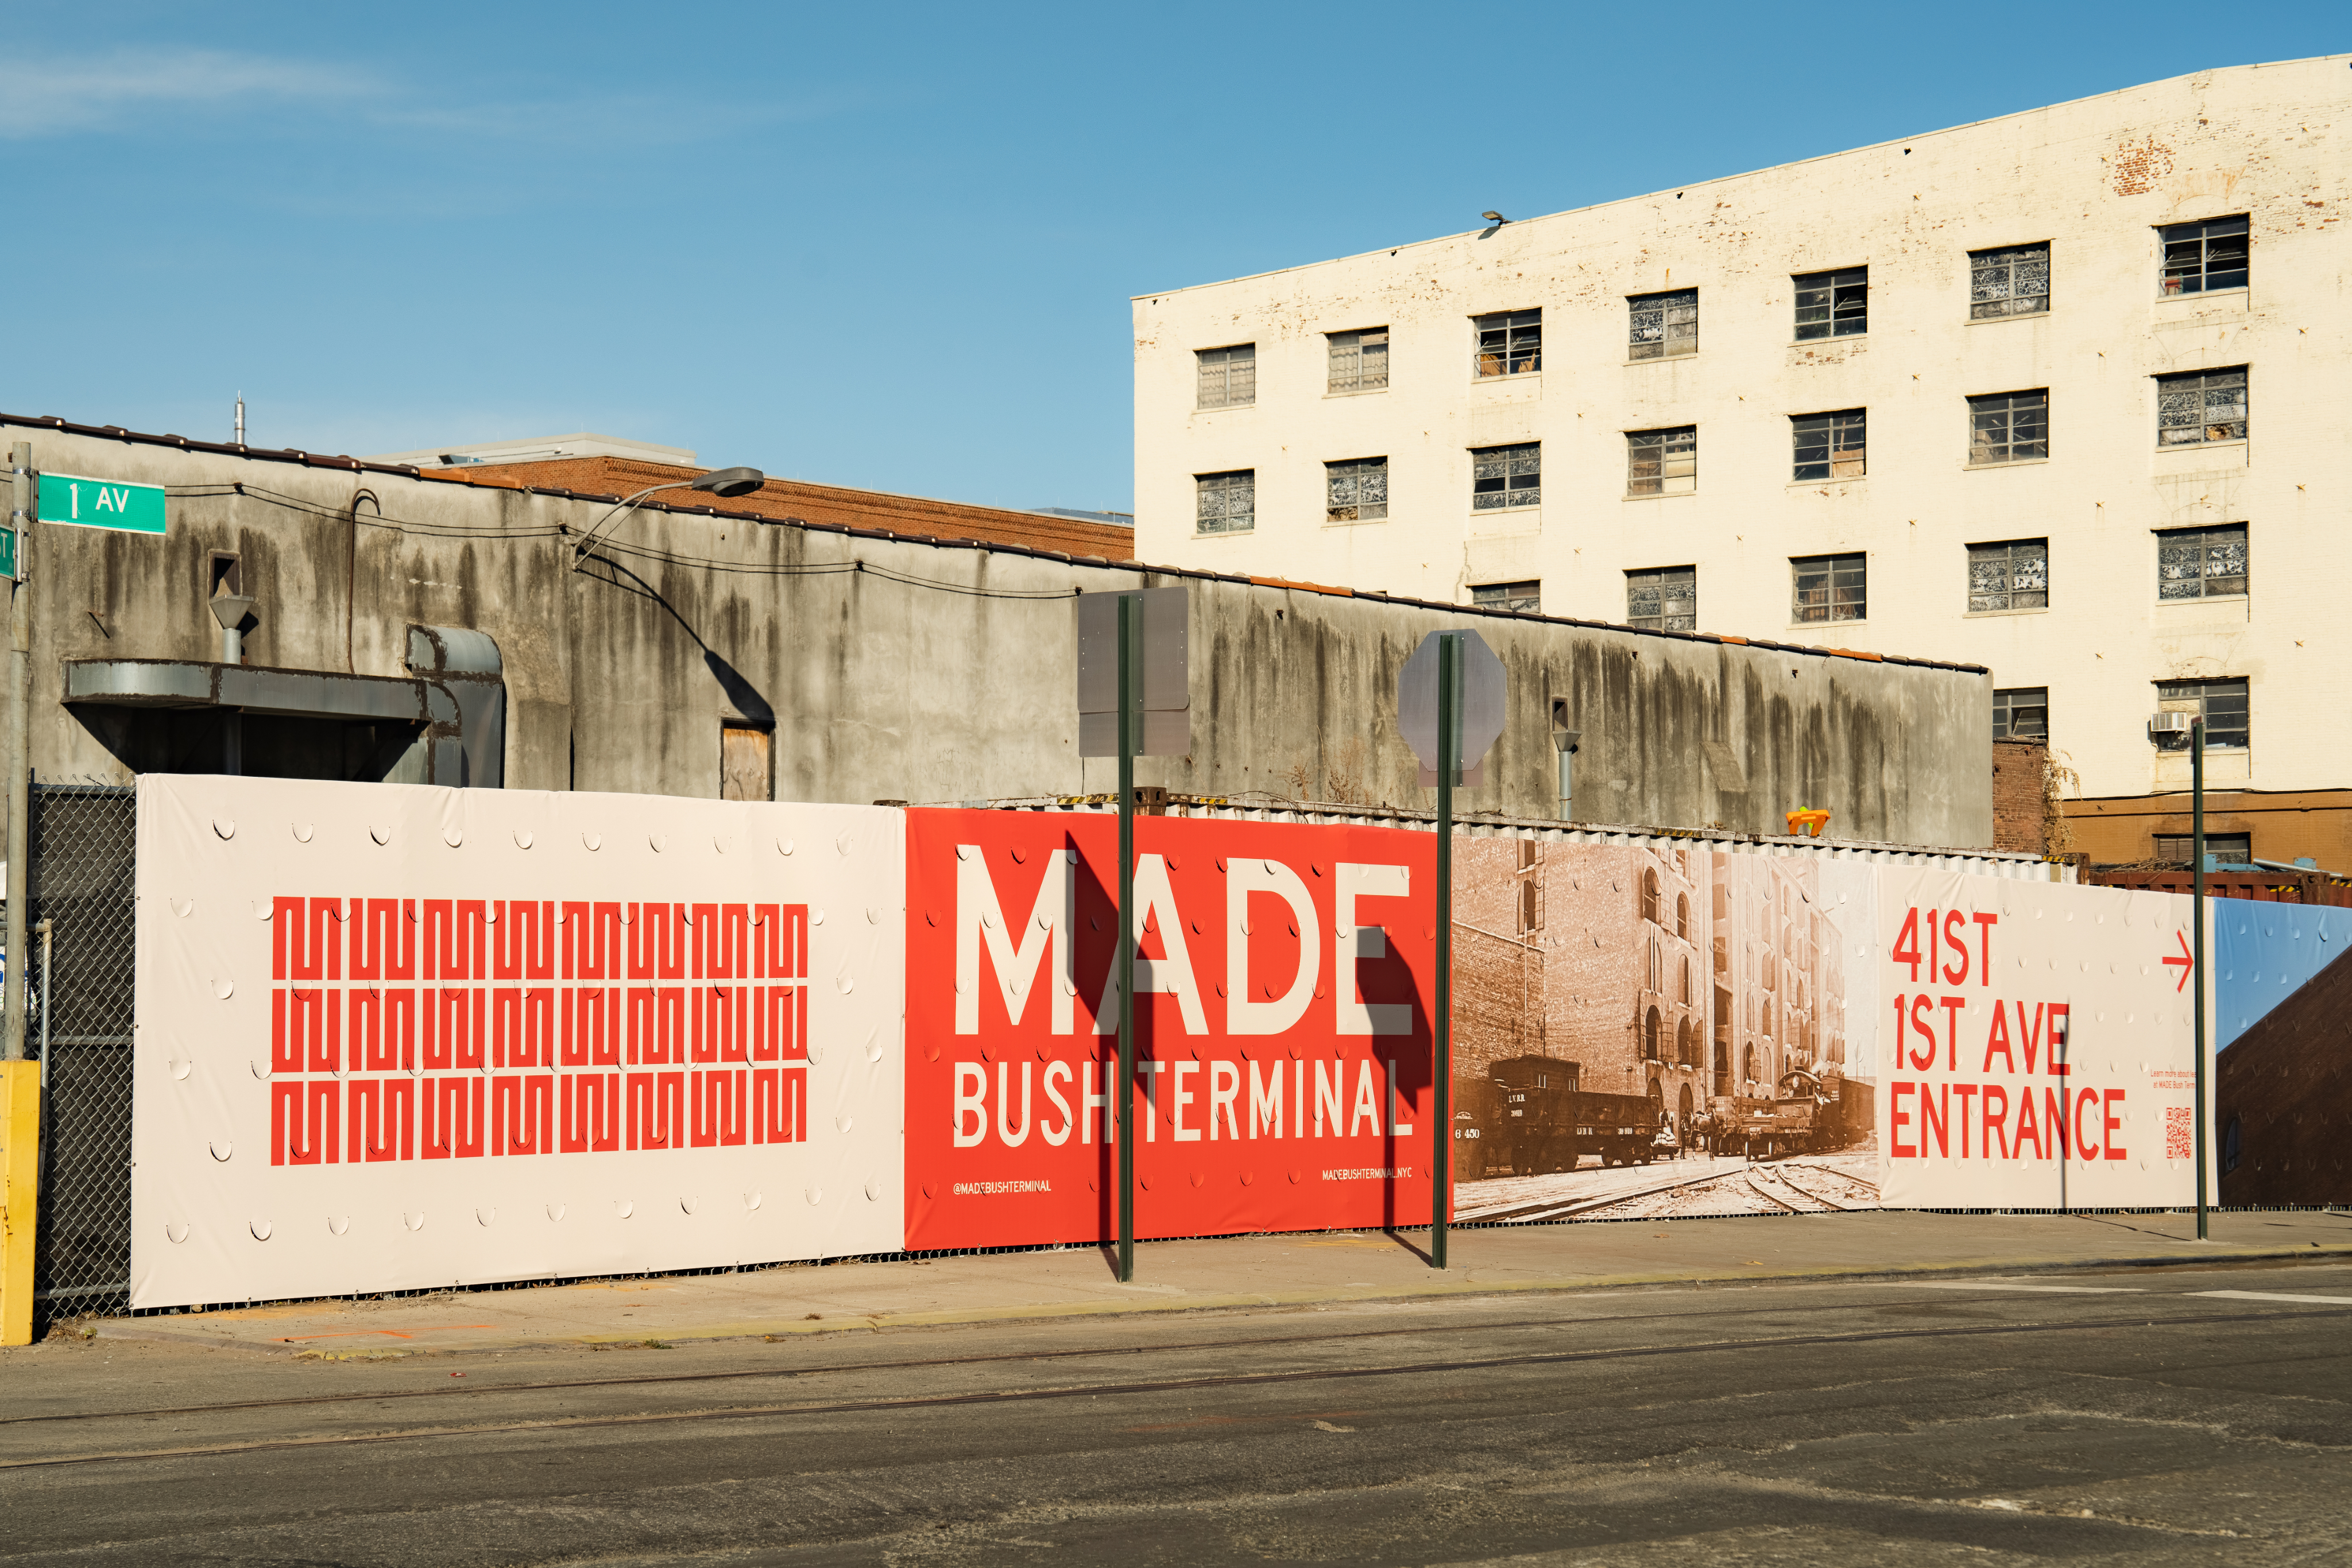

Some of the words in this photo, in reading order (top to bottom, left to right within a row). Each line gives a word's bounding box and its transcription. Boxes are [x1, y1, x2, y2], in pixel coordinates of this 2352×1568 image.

[69, 483, 78, 519] 1
[95, 487, 129, 513] AV
[0, 532, 7, 557] T
[955, 844, 1413, 1035] MADE
[1892, 907, 1998, 987] 41ST
[1894, 993, 1965, 1071] 1ST
[1983, 999, 2071, 1076] AVE
[2150, 1068, 2164, 1077] Learn
[2177, 1070, 2189, 1078] about
[2153, 1081, 2158, 1089] at
[2159, 1081, 2172, 1089] MADE
[2173, 1081, 2183, 1089] Bush
[2184, 1081, 2196, 1089] Term
[953, 1060, 1114, 1148] BUSH
[1138, 1059, 1413, 1143] TERMINAL
[1890, 1082, 2126, 1161] ENTRANCE
[953, 1180, 1051, 1195] @MADEBUSHTERMINAL
[1322, 1167, 1412, 1180] MADEBUSHTERMINAL.NYC
